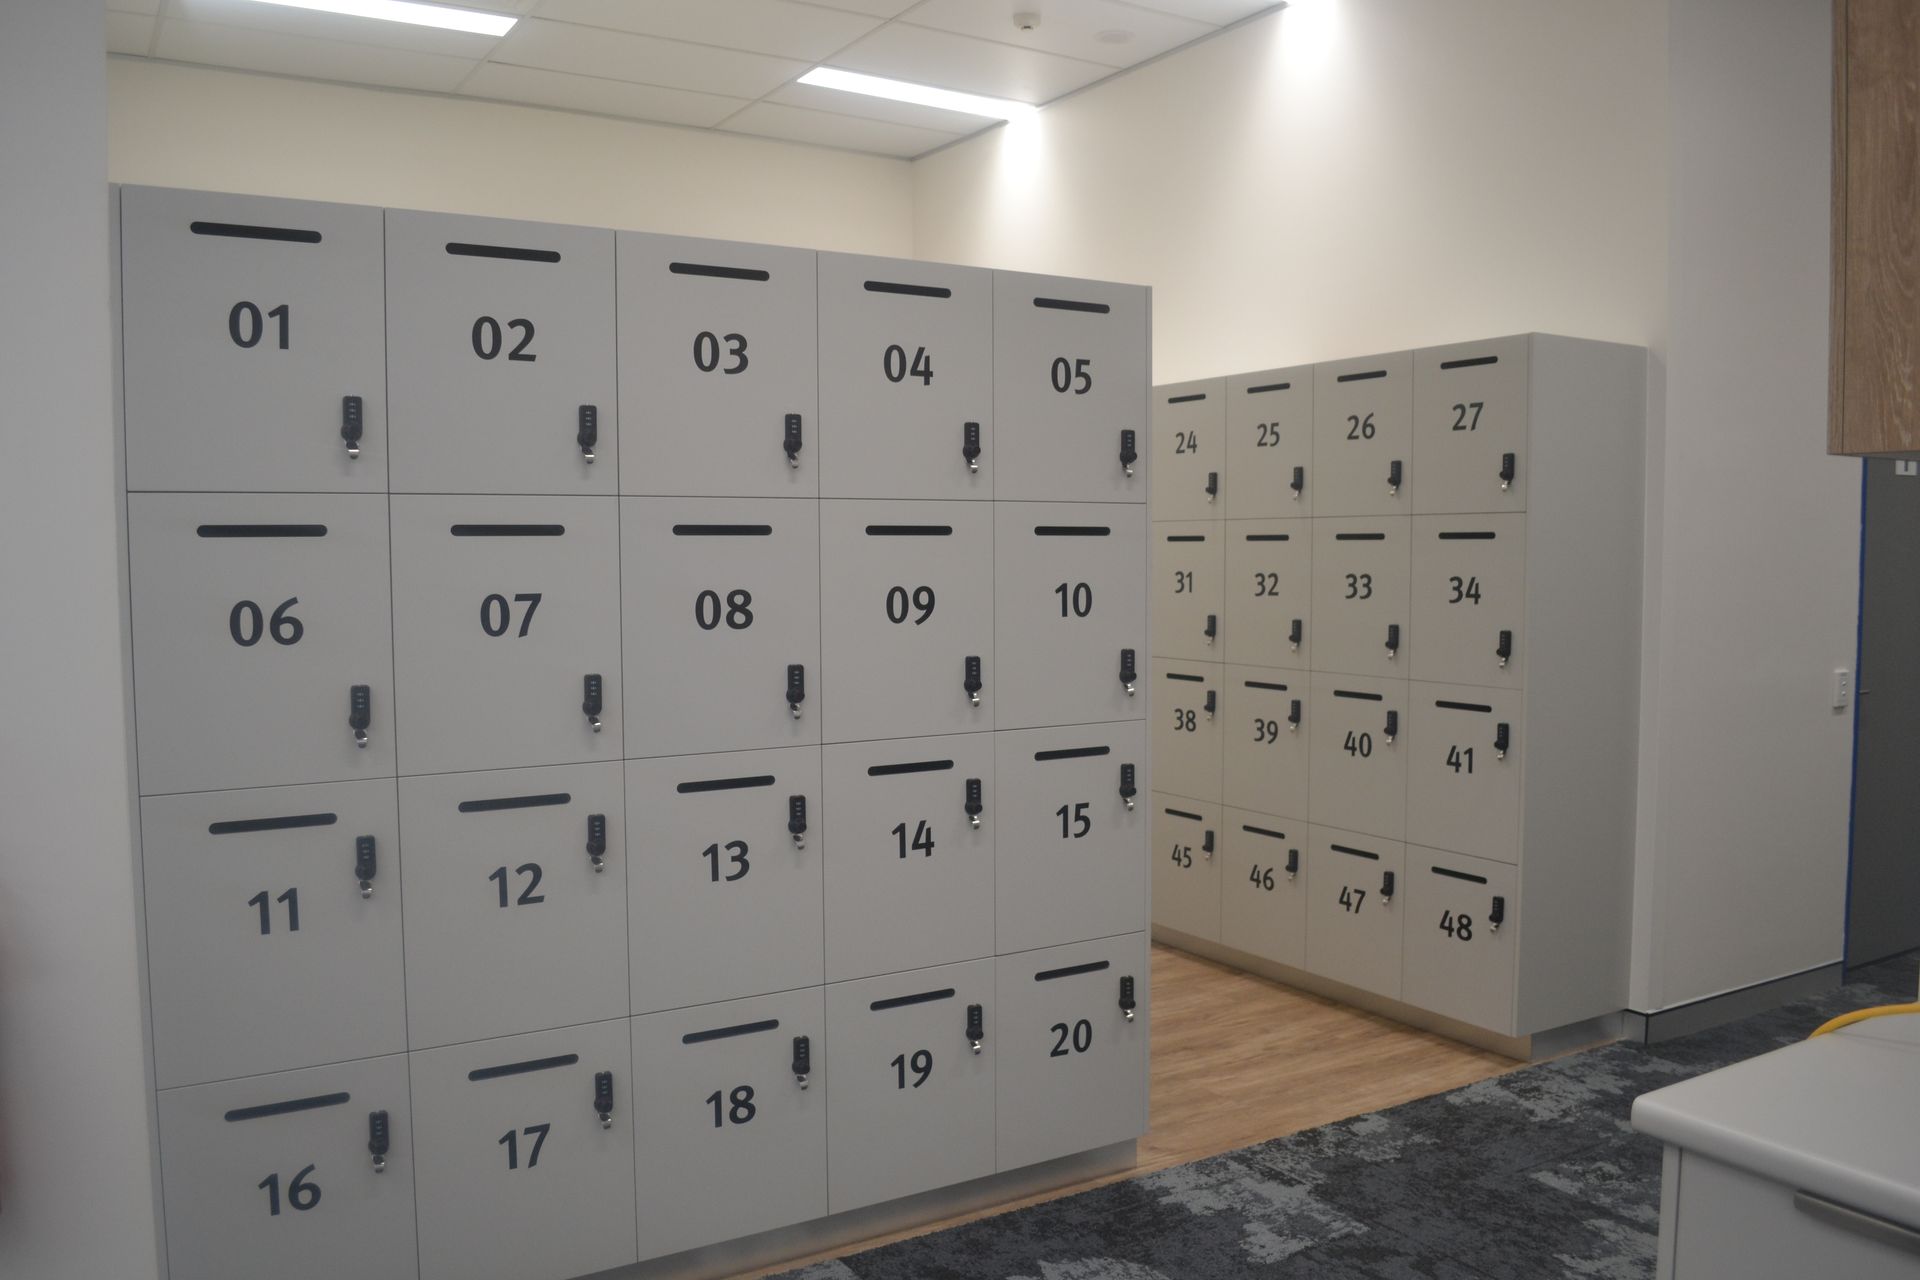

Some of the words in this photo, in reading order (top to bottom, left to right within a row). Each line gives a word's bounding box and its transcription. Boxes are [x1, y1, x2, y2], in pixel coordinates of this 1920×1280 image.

[228, 300, 290, 350] 01
[471, 315, 537, 363] 02
[693, 330, 749, 375] 03
[883, 344, 934, 386] 04
[1050, 356, 1092, 395] 05
[1256, 421, 1281, 448] 25
[1346, 412, 1376, 441] 26
[1452, 401, 1484, 432] 27
[1175, 430, 1198, 455] 24
[1054, 582, 1093, 618] 10
[1174, 570, 1193, 594] 31
[1254, 572, 1280, 597] 32
[1345, 573, 1373, 600] 33
[1448, 575, 1482, 605] 34
[229, 596, 304, 648] 06
[479, 592, 543, 639] 07
[694, 588, 754, 631] 08
[885, 585, 936, 626] 09
[1174, 708, 1197, 733] 38
[1253, 718, 1279, 745] 39
[1343, 730, 1373, 758] 40
[1446, 744, 1474, 774] 41
[891, 819, 935, 859] 14
[1055, 802, 1091, 839] 15
[702, 839, 750, 883] 13
[1171, 843, 1193, 869] 45
[488, 862, 545, 909] 12
[1249, 864, 1275, 892] 46
[247, 887, 300, 936] 11
[1338, 885, 1367, 915] 47
[1439, 909, 1473, 942] 48
[1049, 1018, 1093, 1058] 20
[890, 1049, 933, 1090] 19
[705, 1085, 757, 1129] 18
[498, 1122, 551, 1170] 17
[257, 1163, 322, 1217] 16
